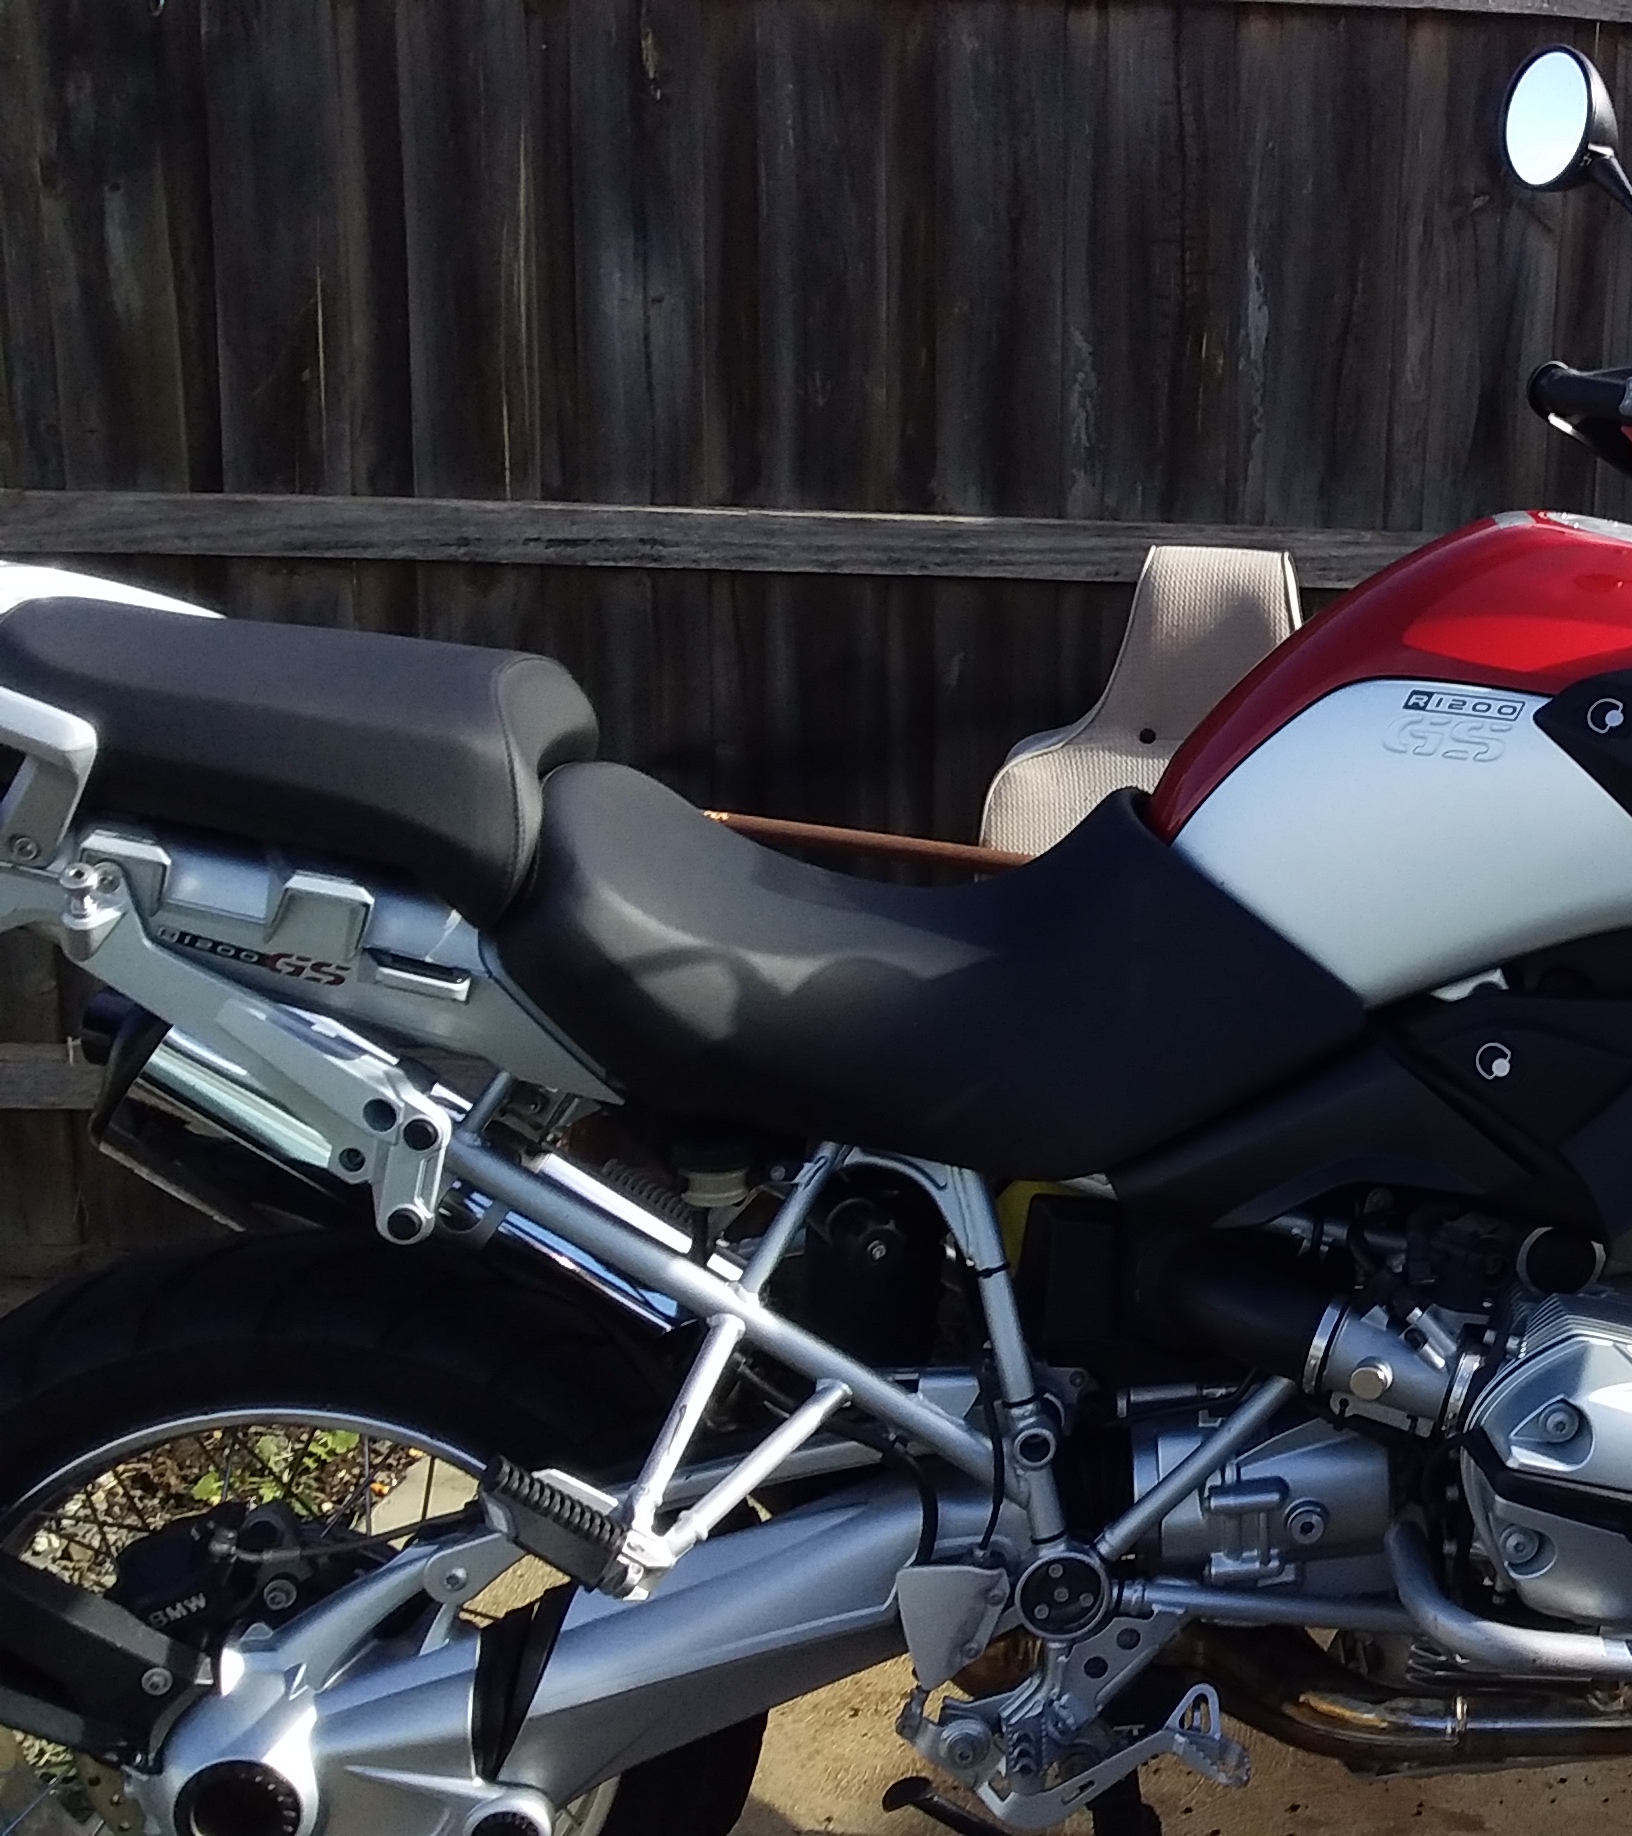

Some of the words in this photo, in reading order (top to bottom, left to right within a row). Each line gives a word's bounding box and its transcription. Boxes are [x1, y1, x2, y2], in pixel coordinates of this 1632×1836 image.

[1405, 691, 1520, 718] R1200
[1382, 714, 1513, 763] GS
[263, 952, 351, 986] GS
[149, 1592, 207, 1628] BMW
